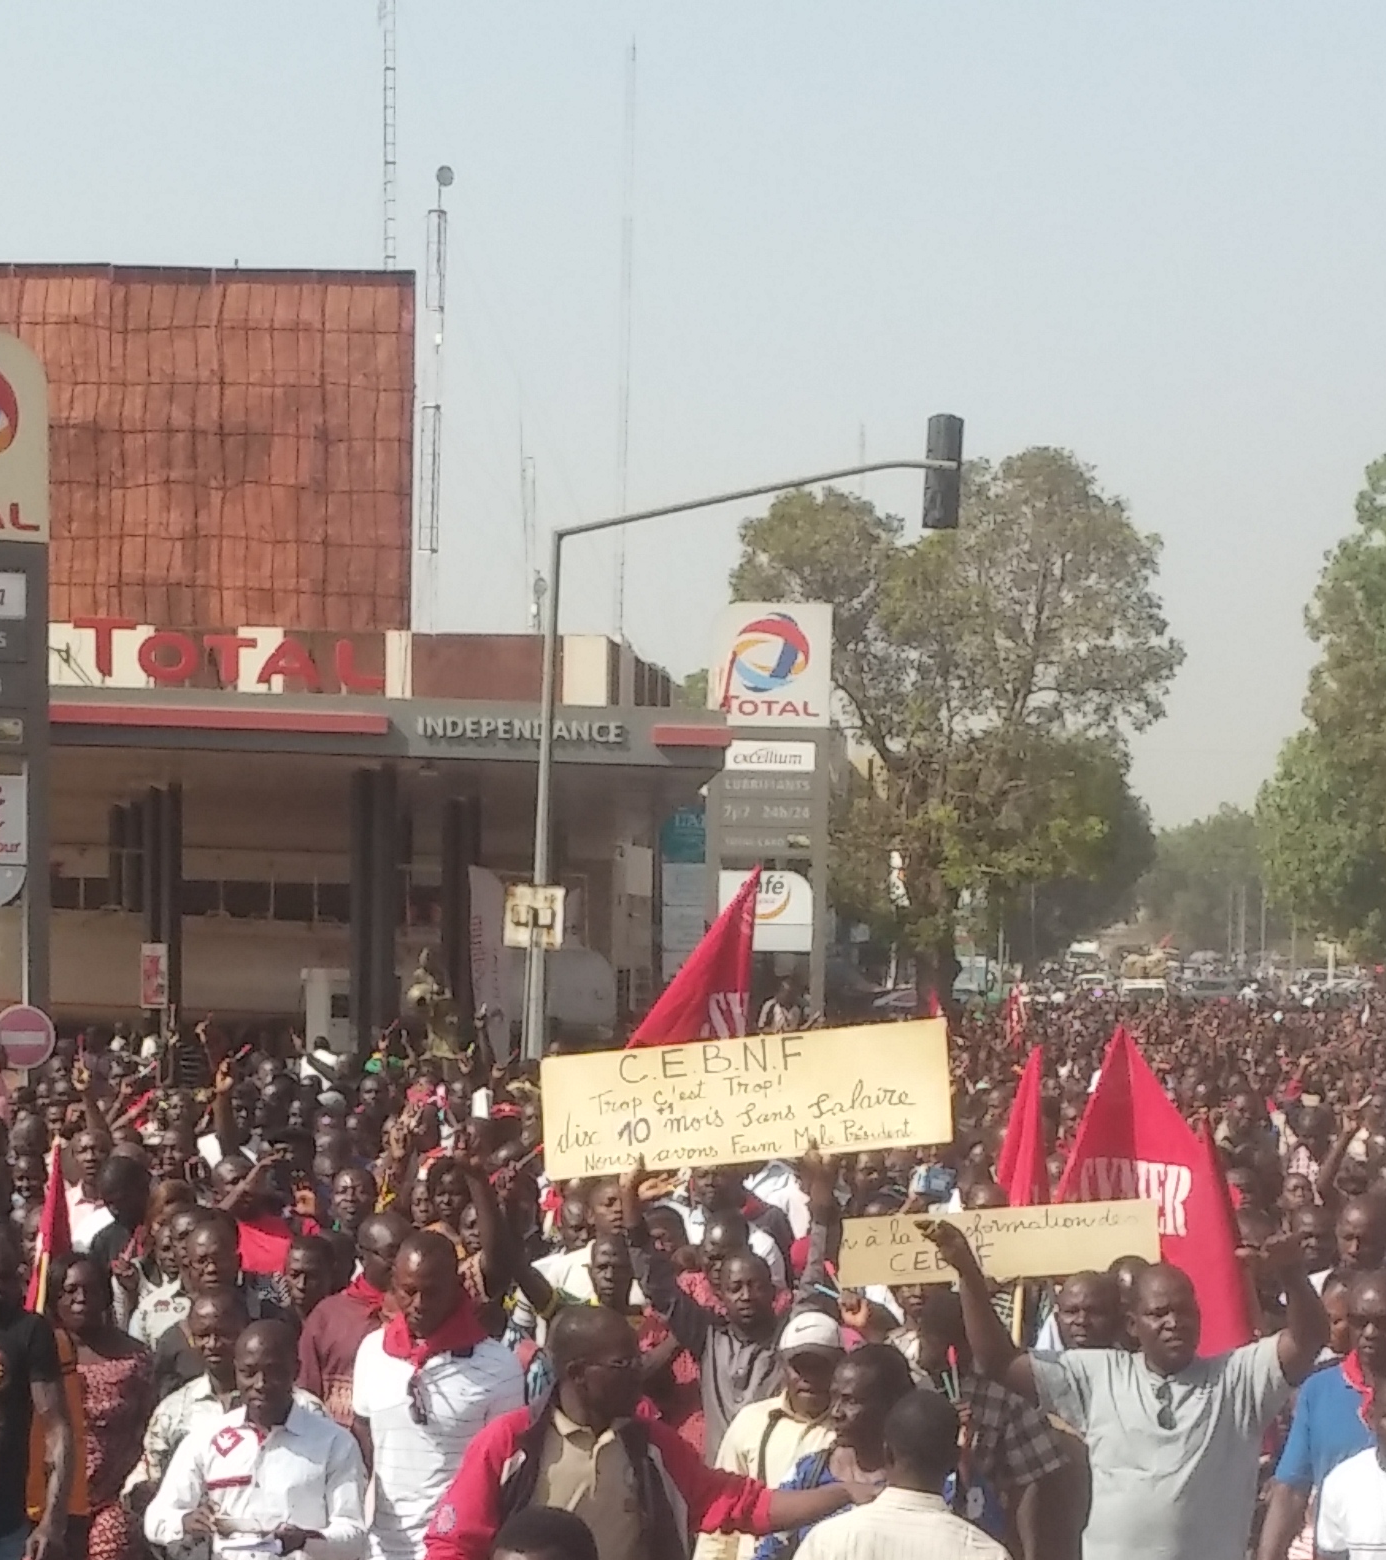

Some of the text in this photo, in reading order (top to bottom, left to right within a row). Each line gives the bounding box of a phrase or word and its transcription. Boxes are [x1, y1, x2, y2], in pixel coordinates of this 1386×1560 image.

[73, 616, 386, 690] TOTAL
[726, 695, 821, 718] TOTAL
[416, 715, 624, 744] INDEPENDANCE
[732, 749, 803, 766] excellium
[589, 1089, 643, 1119] Trop
[618, 1117, 651, 1147] 10
[663, 1106, 725, 1133] mois
[651, 1145, 719, 1163] avons
[889, 1243, 995, 1272] CEBF
